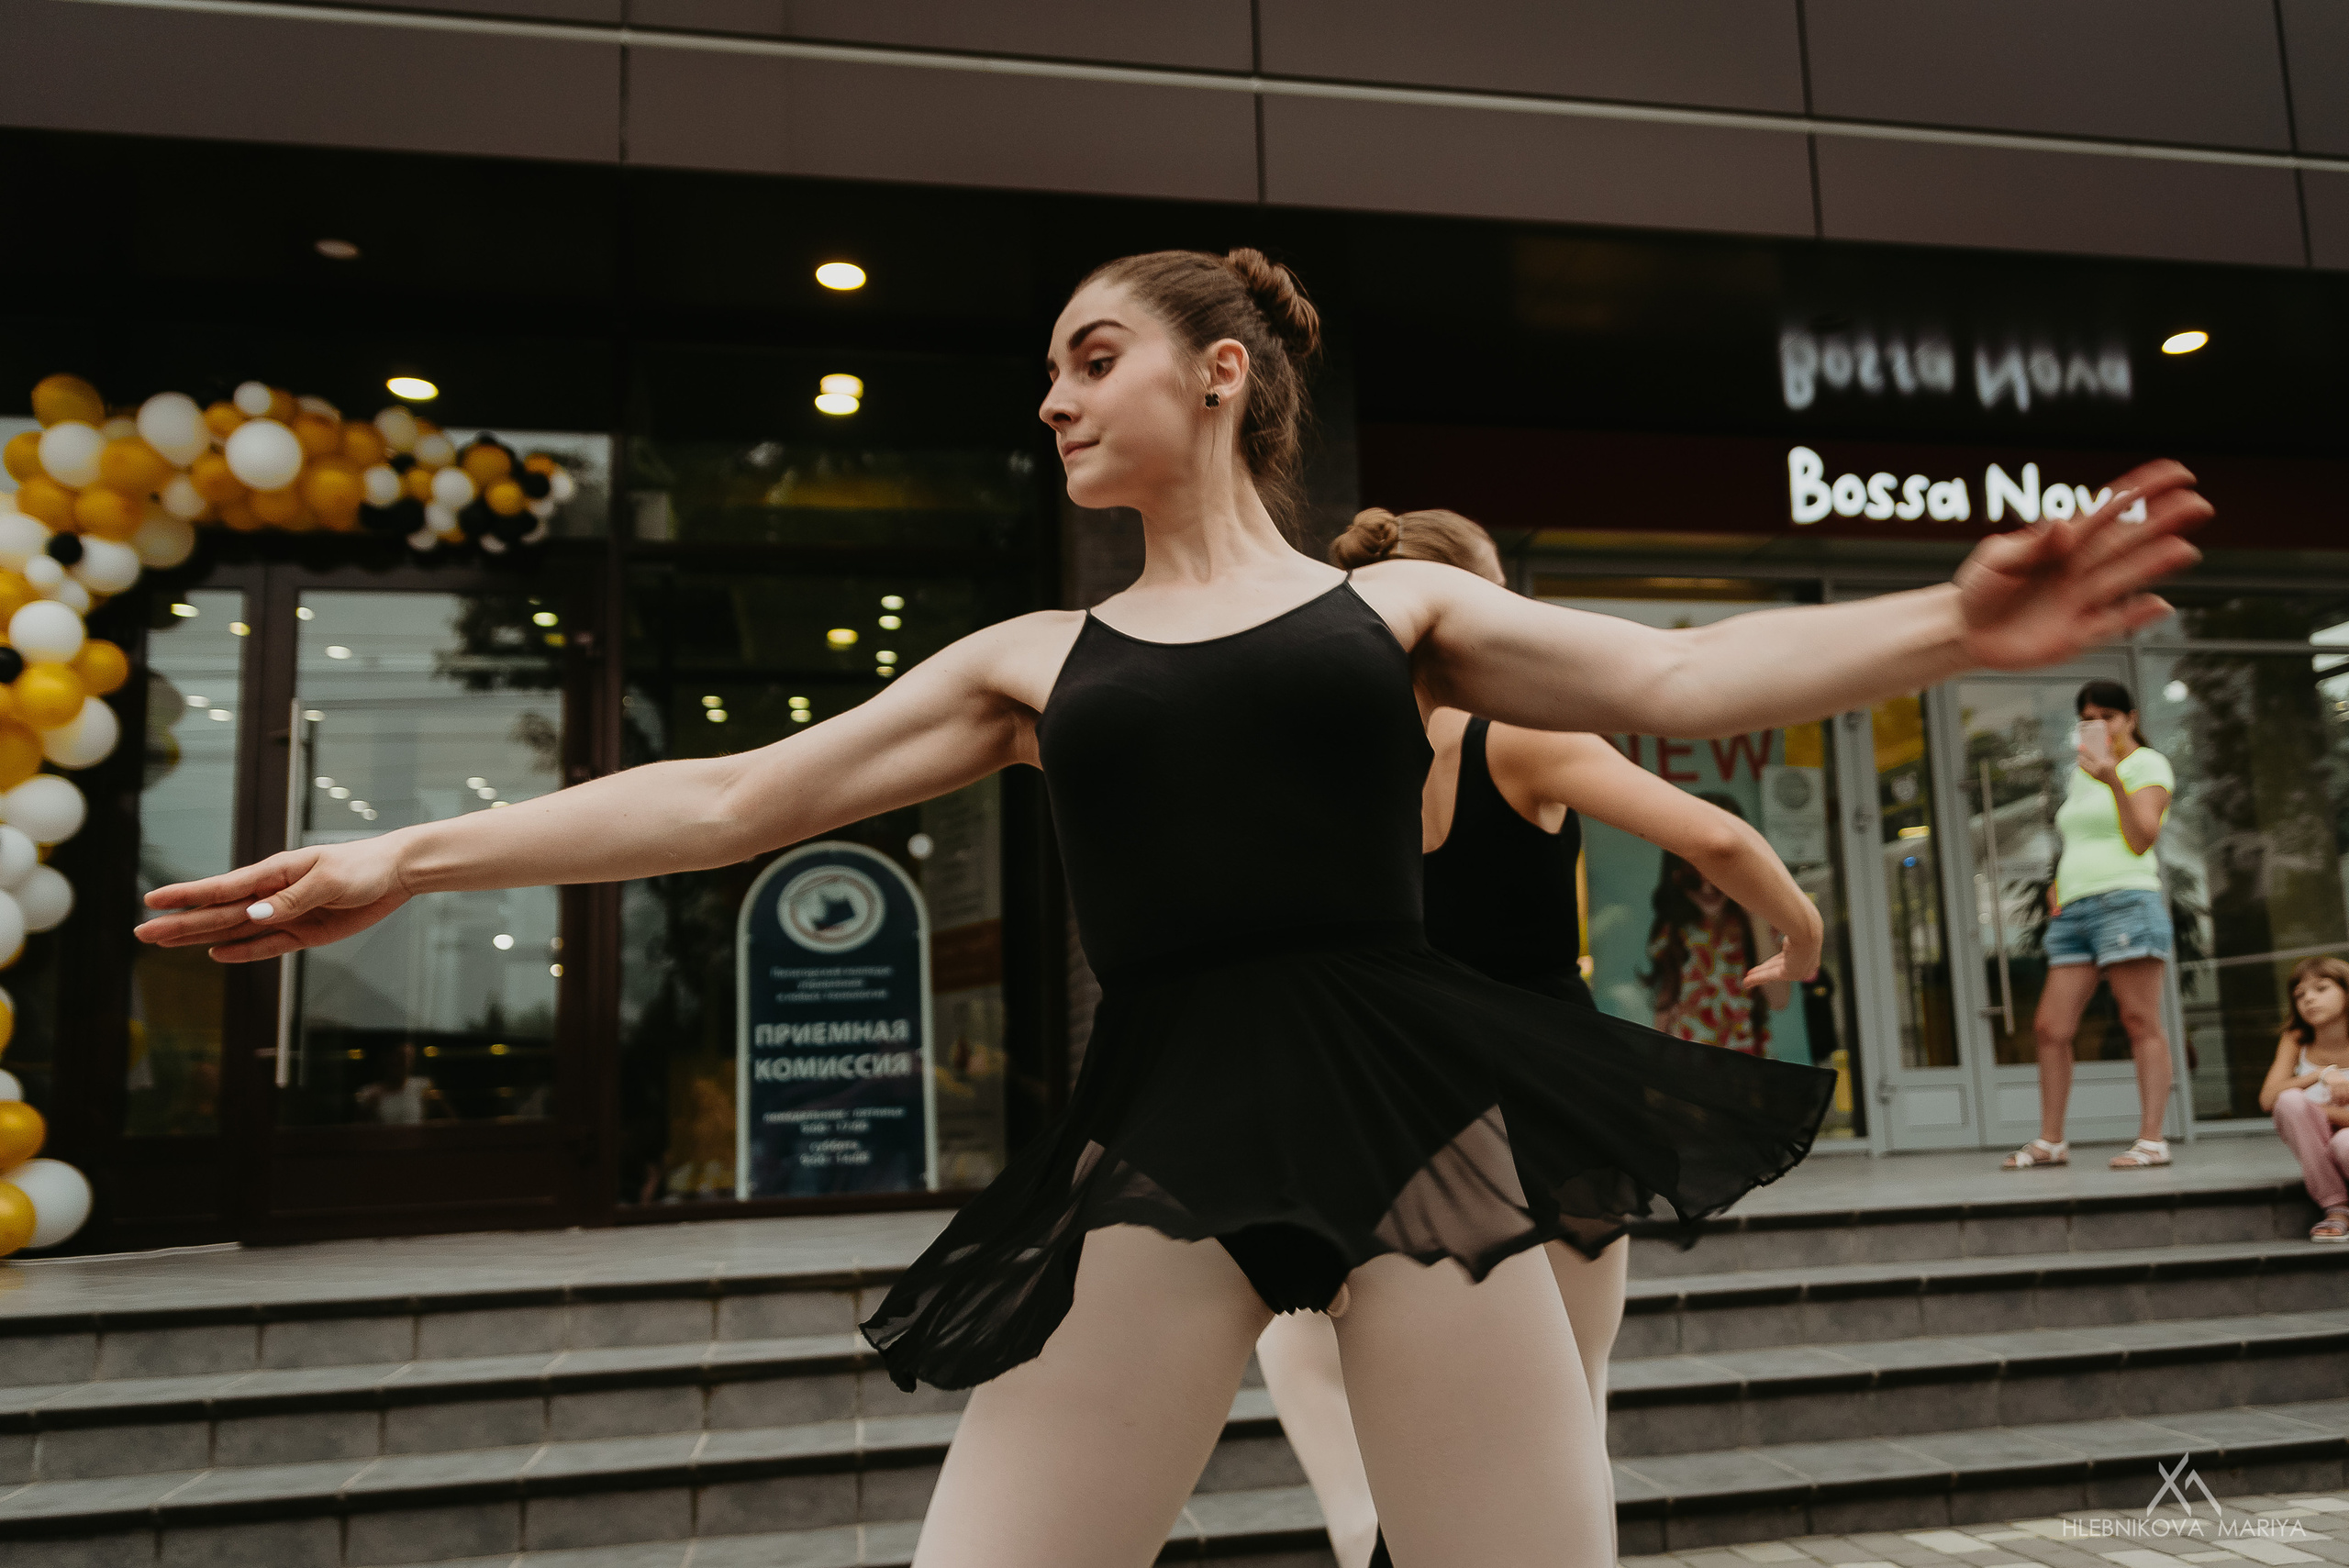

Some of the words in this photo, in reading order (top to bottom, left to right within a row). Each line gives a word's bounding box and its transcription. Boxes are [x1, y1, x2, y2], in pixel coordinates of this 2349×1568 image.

[1788, 446, 1970, 524] Bossa
[754, 1018, 910, 1047] ПРИЕМНАЯ
[754, 1052, 911, 1082] КОМИССИЯ
